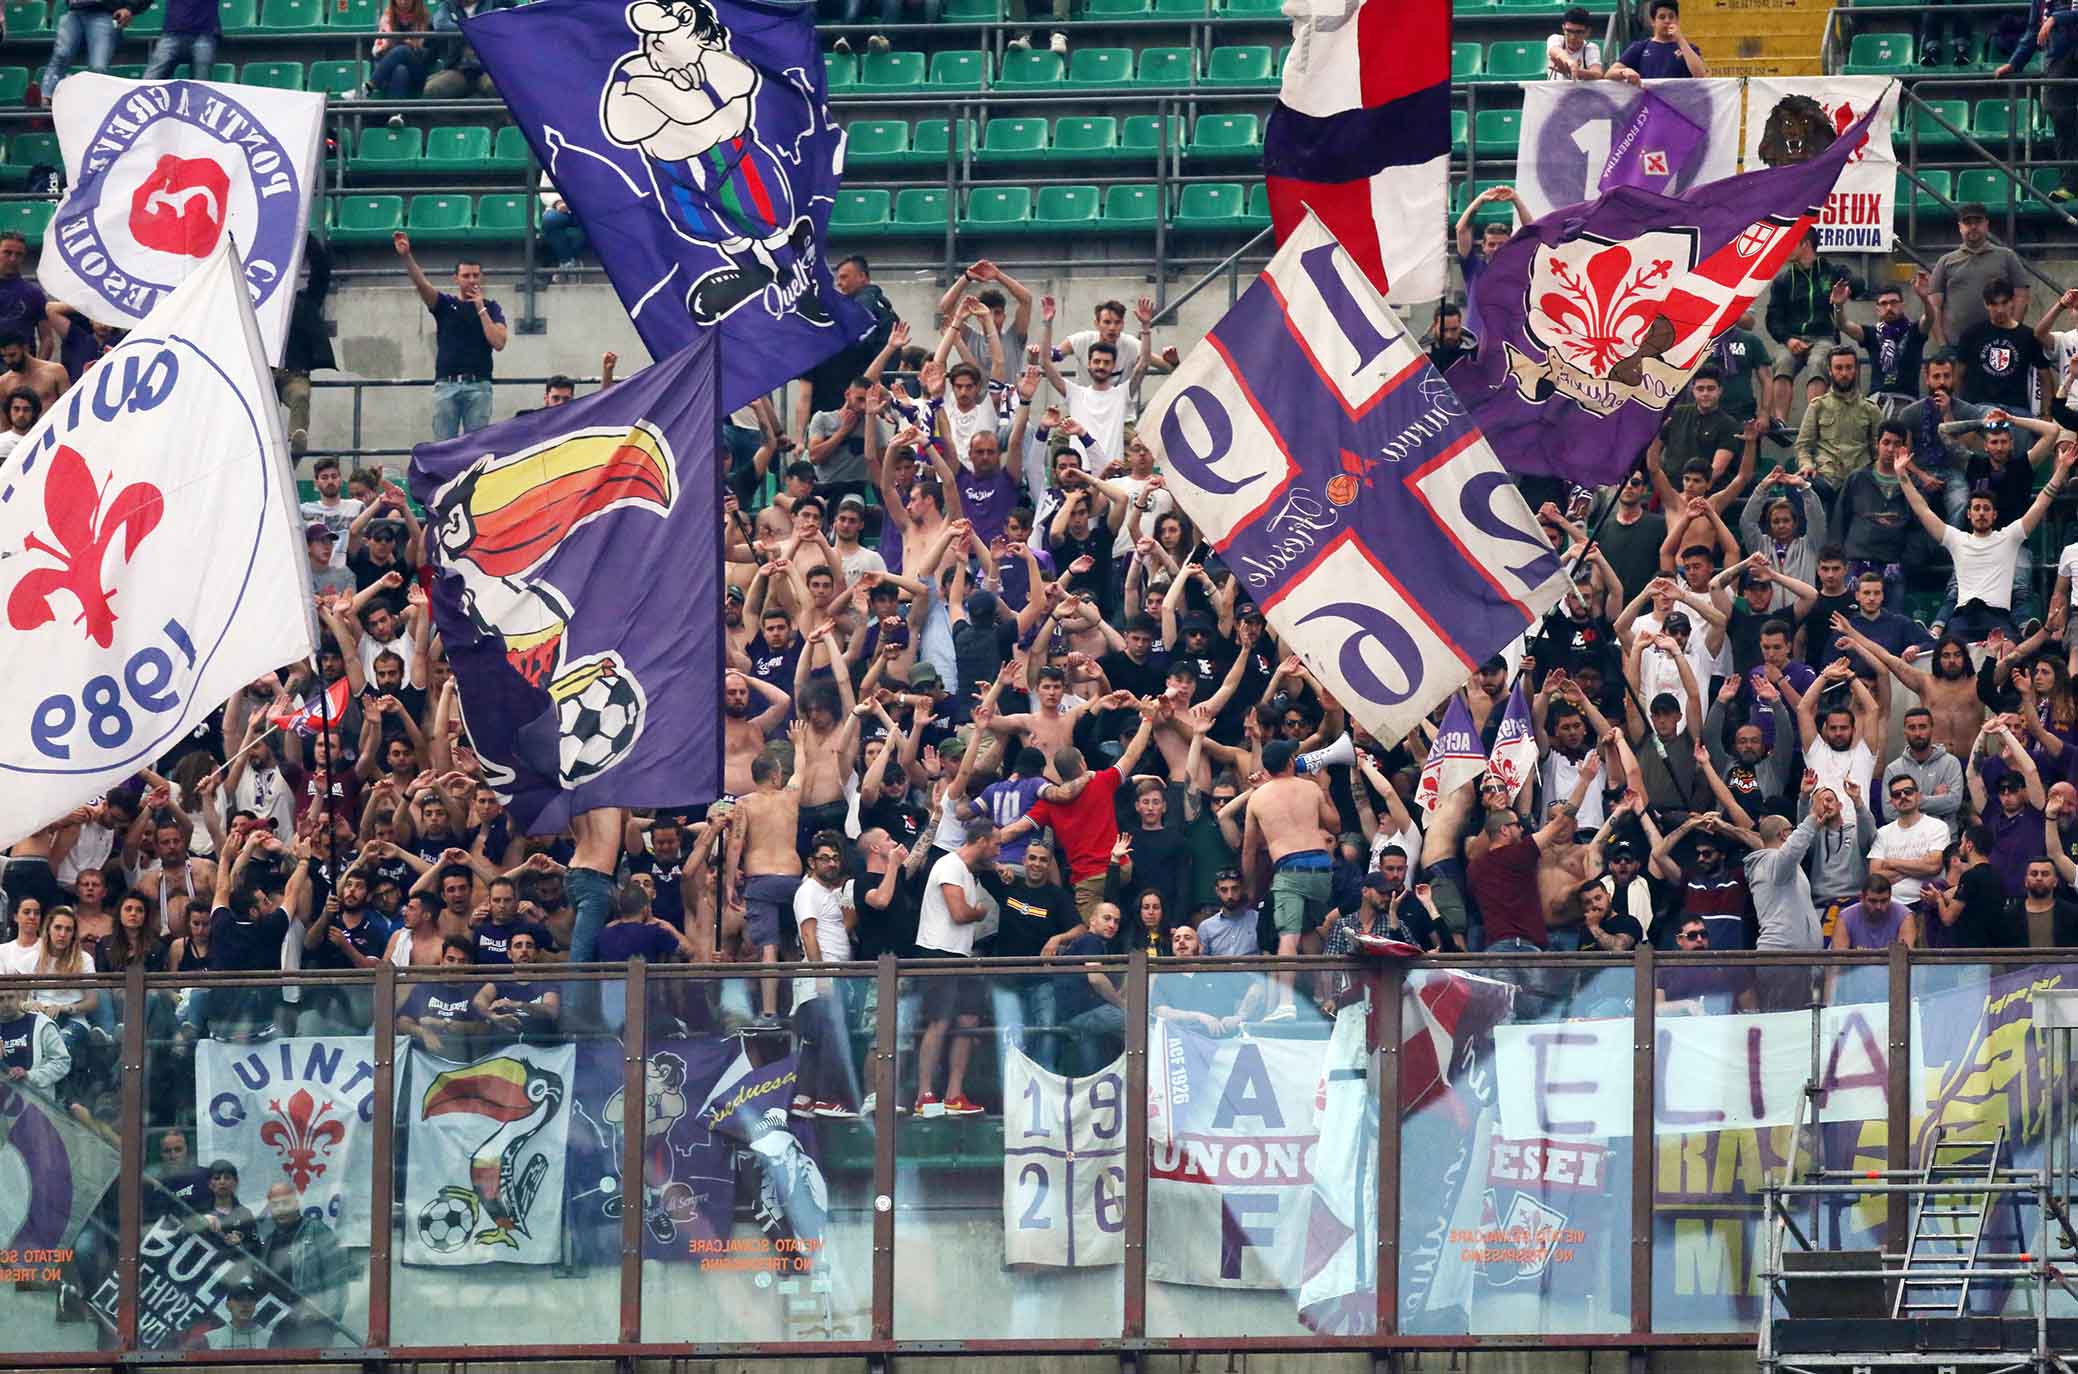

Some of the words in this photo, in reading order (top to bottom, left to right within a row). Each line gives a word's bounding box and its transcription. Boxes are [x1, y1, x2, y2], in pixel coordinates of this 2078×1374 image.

[1637, 106, 1650, 128] ACF
[1602, 124, 1641, 178] FIORENTINA
[1815, 192, 1882, 225] SEUX
[1168, 1037, 1185, 1065] ACF
[1527, 1008, 1888, 1135] ELIA
[1170, 1066, 1190, 1105] 1926
[1211, 1043, 1286, 1129] A
[1491, 1143, 1600, 1187] ESEI
[1221, 1193, 1280, 1279] F
